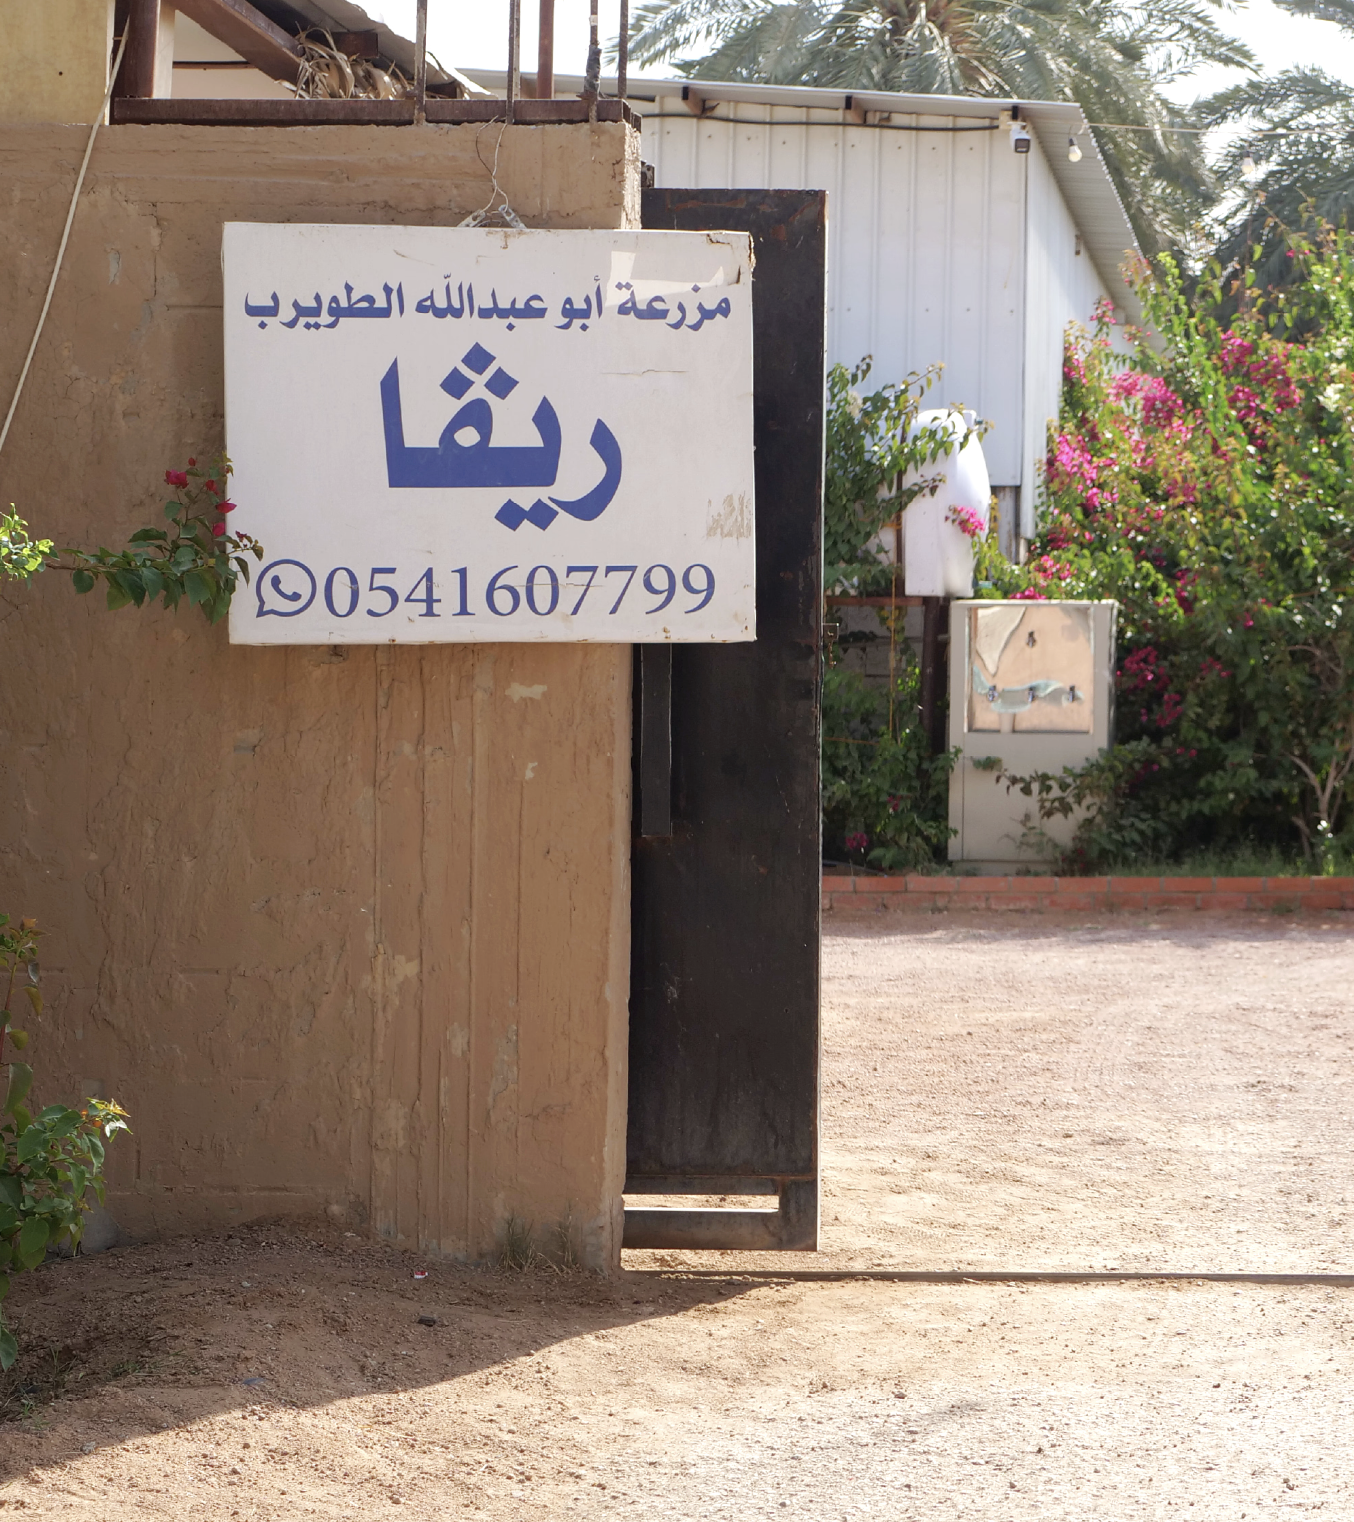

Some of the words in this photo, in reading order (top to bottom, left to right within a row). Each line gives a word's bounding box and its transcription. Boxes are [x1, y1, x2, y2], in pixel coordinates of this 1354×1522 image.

[244, 280, 405, 331] الطويرب
[554, 275, 603, 332] أبو
[616, 281, 732, 332] مزرعة
[323, 563, 716, 618] 0541607799
